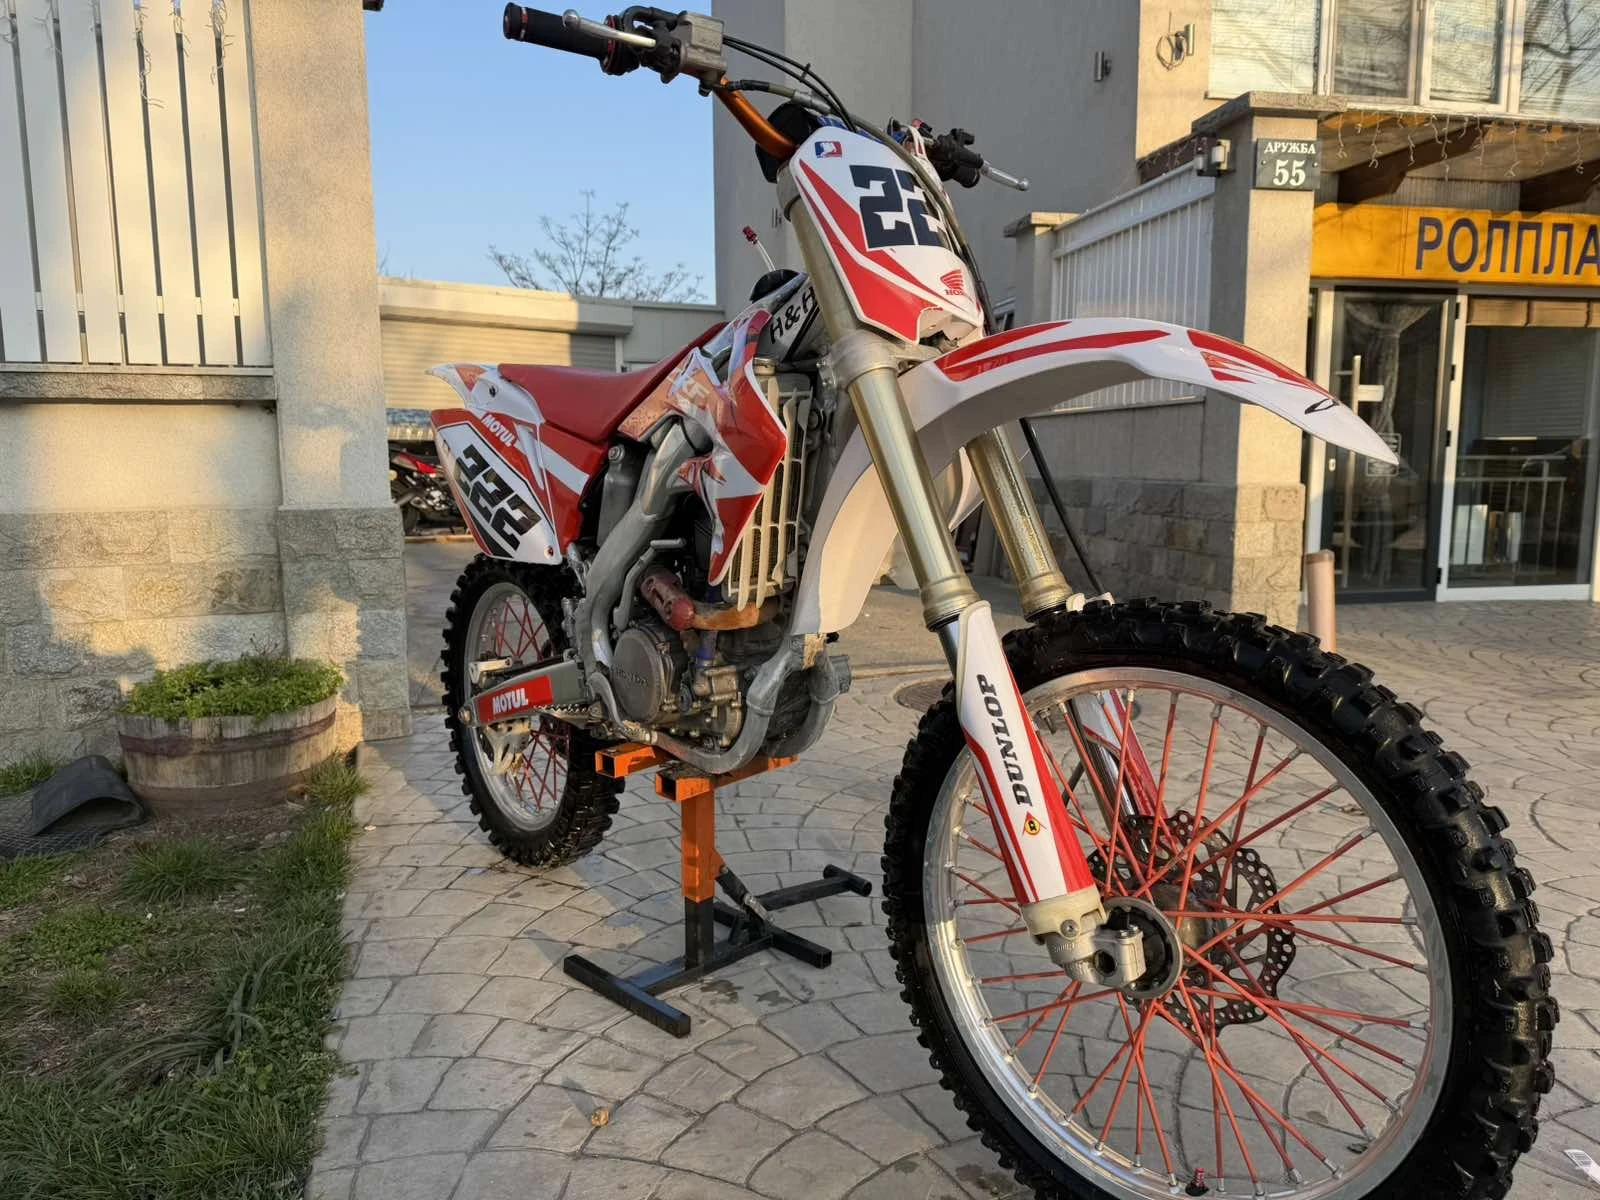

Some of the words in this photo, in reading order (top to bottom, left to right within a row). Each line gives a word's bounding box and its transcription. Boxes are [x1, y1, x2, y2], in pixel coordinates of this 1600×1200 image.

[1263, 141, 1317, 155] ДРУЖБА
[1272, 160, 1306, 186] 55
[481, 413, 517, 448] MOTUL
[455, 444, 542, 551] 222
[492, 688, 529, 714] MOTUL
[976, 673, 1033, 807] DUNLOP
